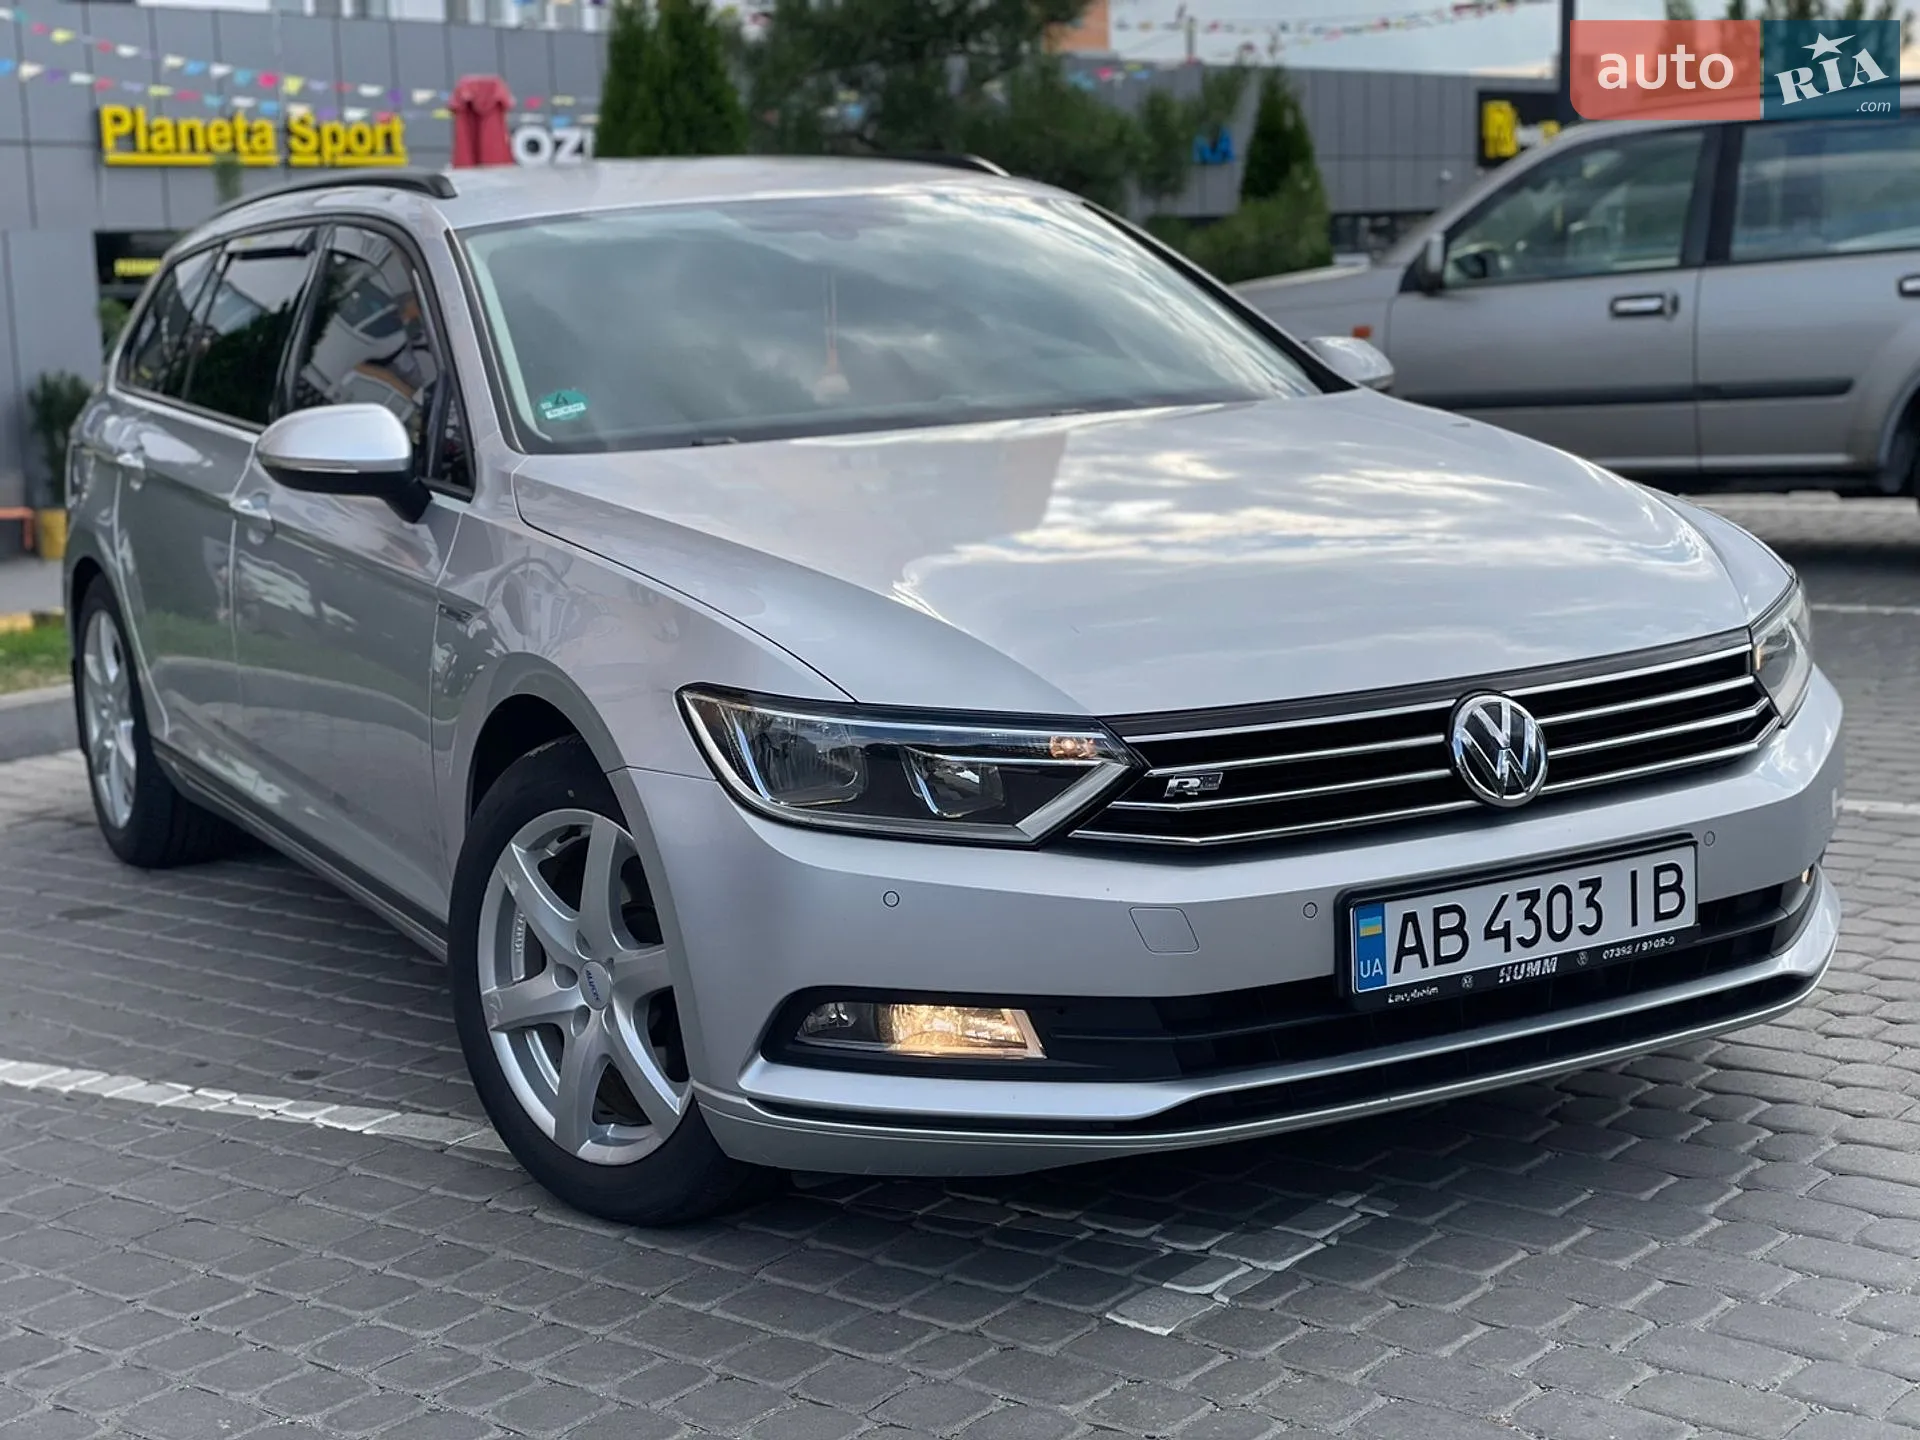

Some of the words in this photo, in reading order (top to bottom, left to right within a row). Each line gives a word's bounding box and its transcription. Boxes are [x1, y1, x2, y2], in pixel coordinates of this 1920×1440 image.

[101, 103, 277, 155] Planeta
[288, 111, 406, 164] Sport
[1393, 902, 1470, 974] AB
[1483, 876, 1604, 953] 4303
[1629, 862, 1687, 927] IB
[1360, 958, 1384, 978] UA
